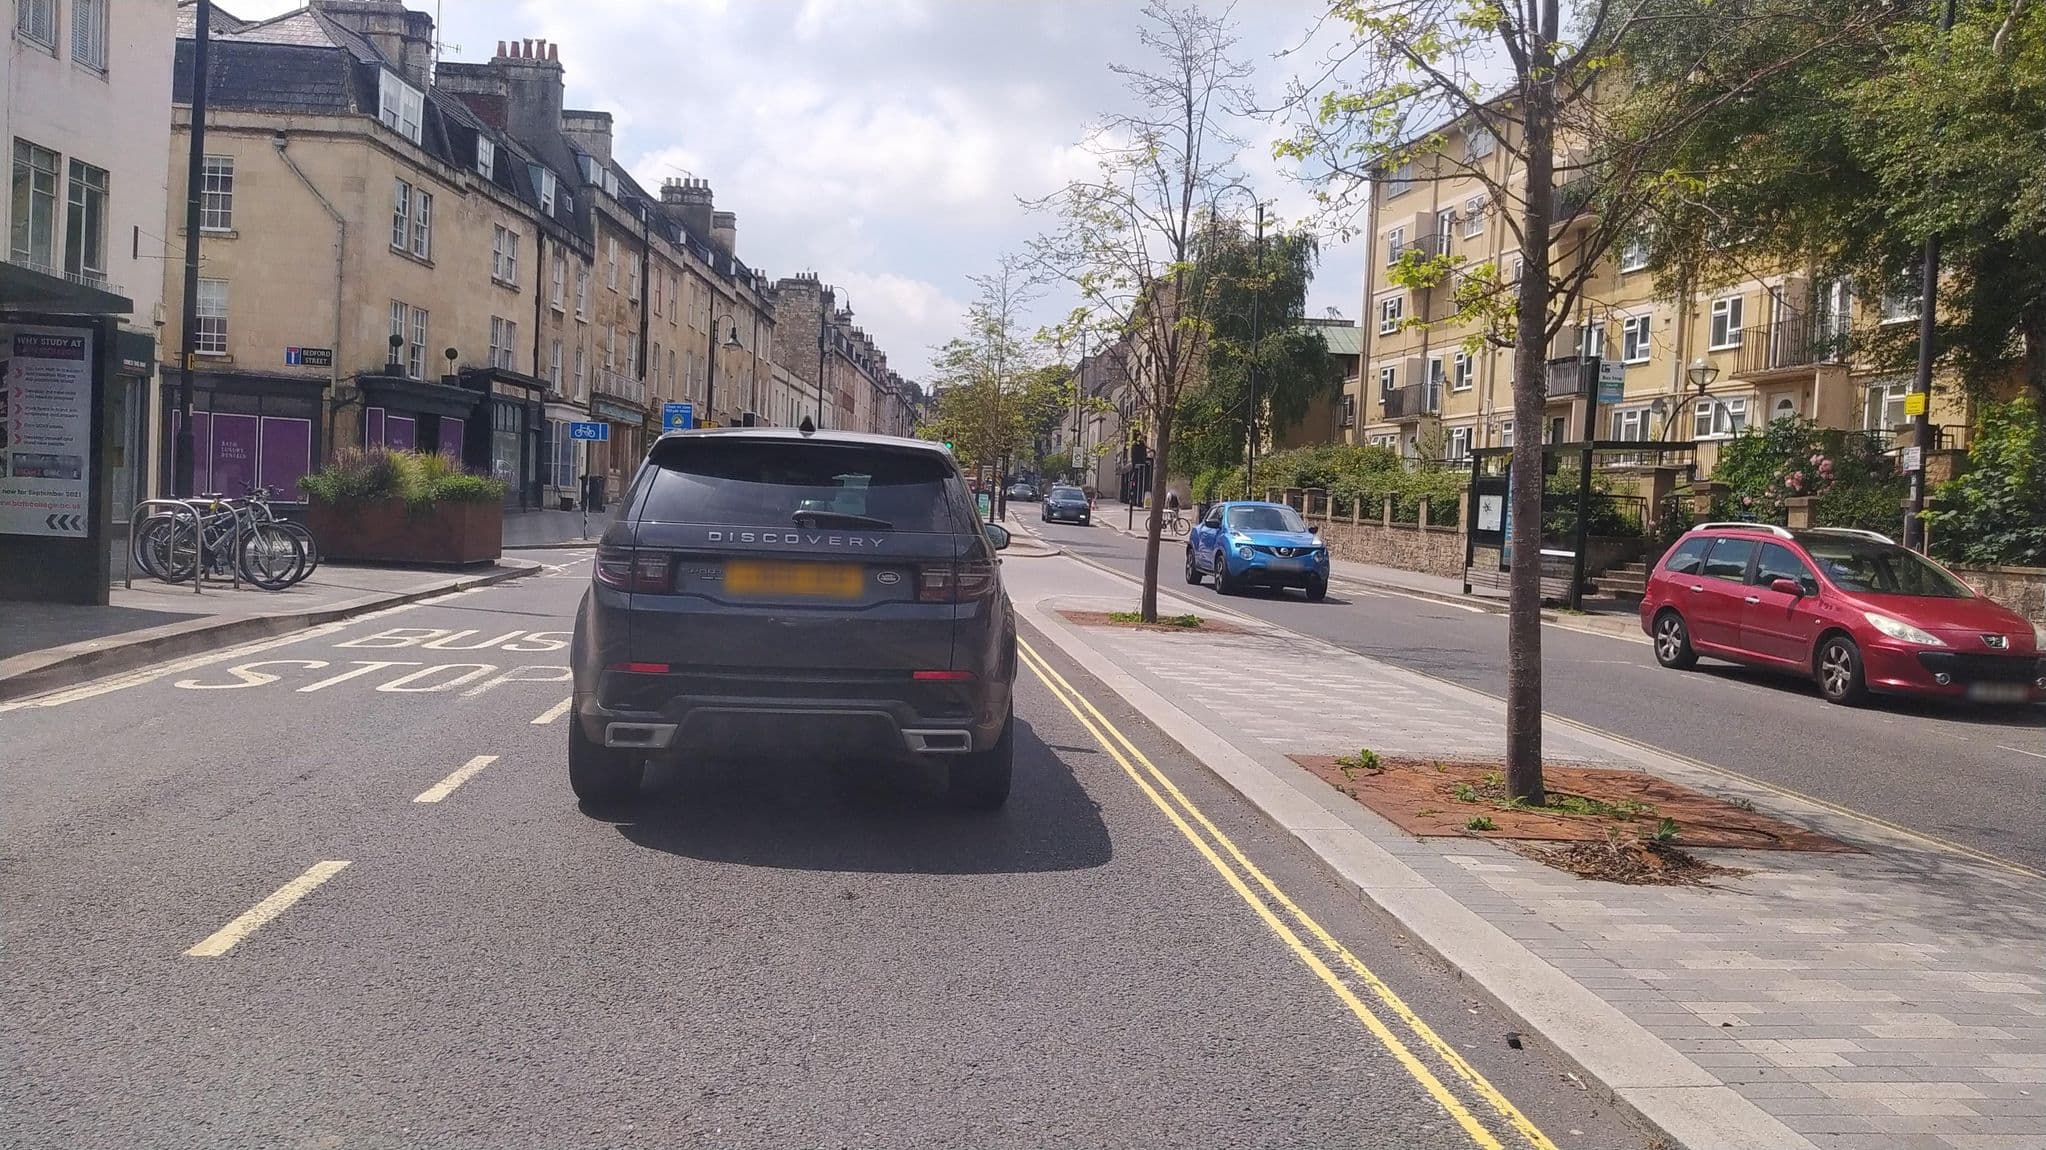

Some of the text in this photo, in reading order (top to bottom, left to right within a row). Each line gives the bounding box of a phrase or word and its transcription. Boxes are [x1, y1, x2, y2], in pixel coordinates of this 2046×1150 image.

[17, 336, 82, 348] WHY STUDY AT
[302, 350, 331, 358] BEDFORD
[305, 357, 328, 365] STREET
[708, 531, 885, 548] DISCOVERY
[332, 628, 573, 652] BUS
[174, 660, 572, 694] STOP
